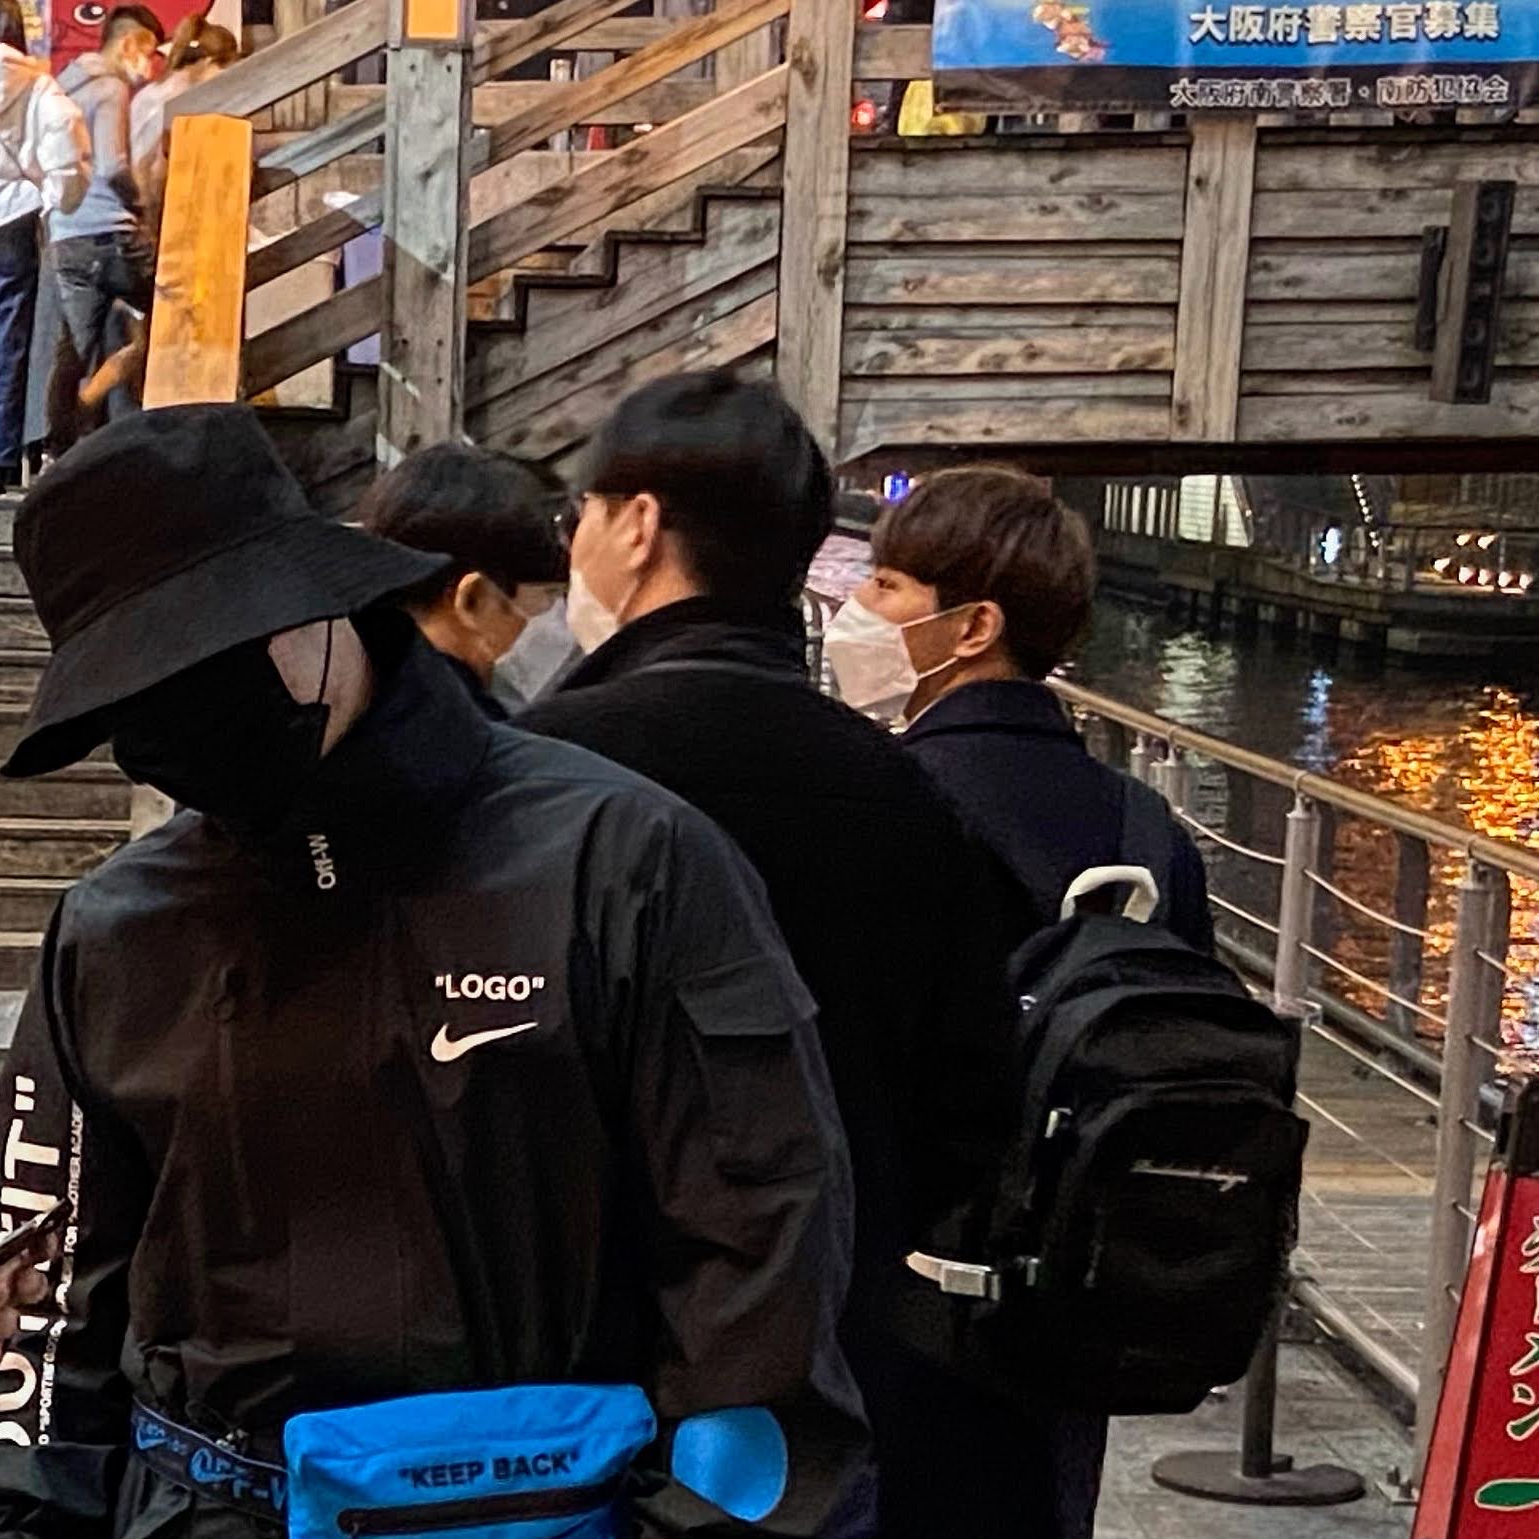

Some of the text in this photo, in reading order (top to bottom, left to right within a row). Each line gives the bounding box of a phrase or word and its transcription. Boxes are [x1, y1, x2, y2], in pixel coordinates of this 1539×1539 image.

[1189, 2, 1500, 45] 大阪府警察官募集
[434, 973, 546, 1001] "LOGO"
